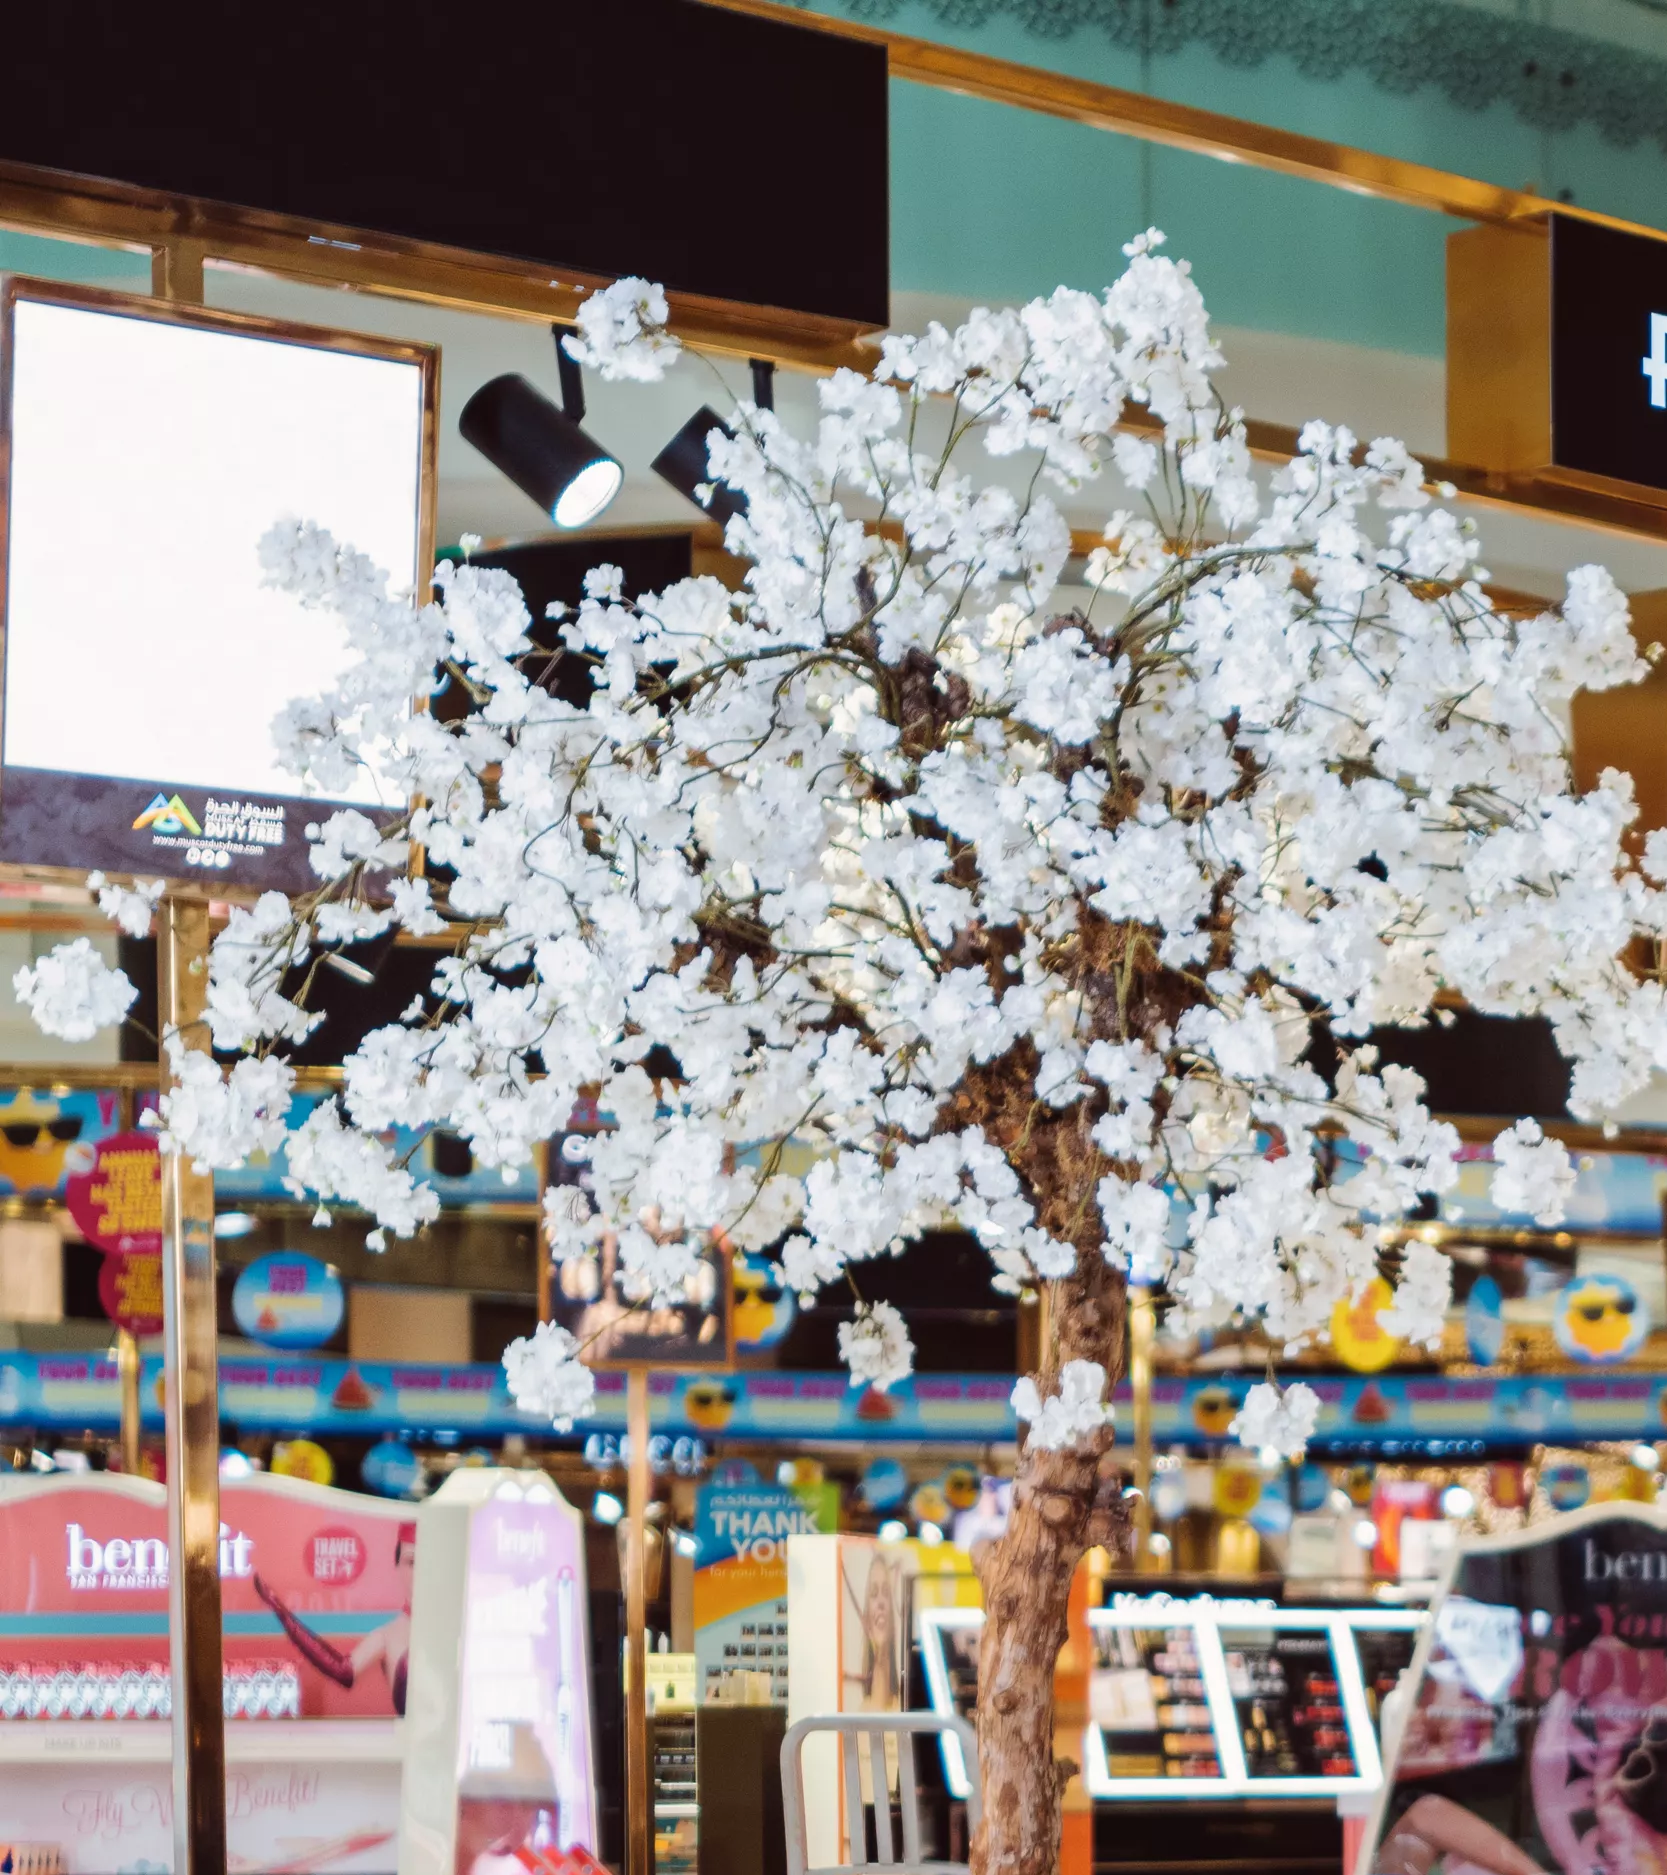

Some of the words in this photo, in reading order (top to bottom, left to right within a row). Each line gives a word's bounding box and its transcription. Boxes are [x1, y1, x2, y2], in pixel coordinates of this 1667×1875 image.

[204, 822, 248, 841] DUTY
[249, 826, 285, 845] FREE
[709, 1510, 820, 1537] THANK
[66, 1522, 254, 1579] benit
[314, 1538, 359, 1556] TRAVEL
[314, 1555, 338, 1577] SET
[102, 1575, 170, 1590] FRANCISC
